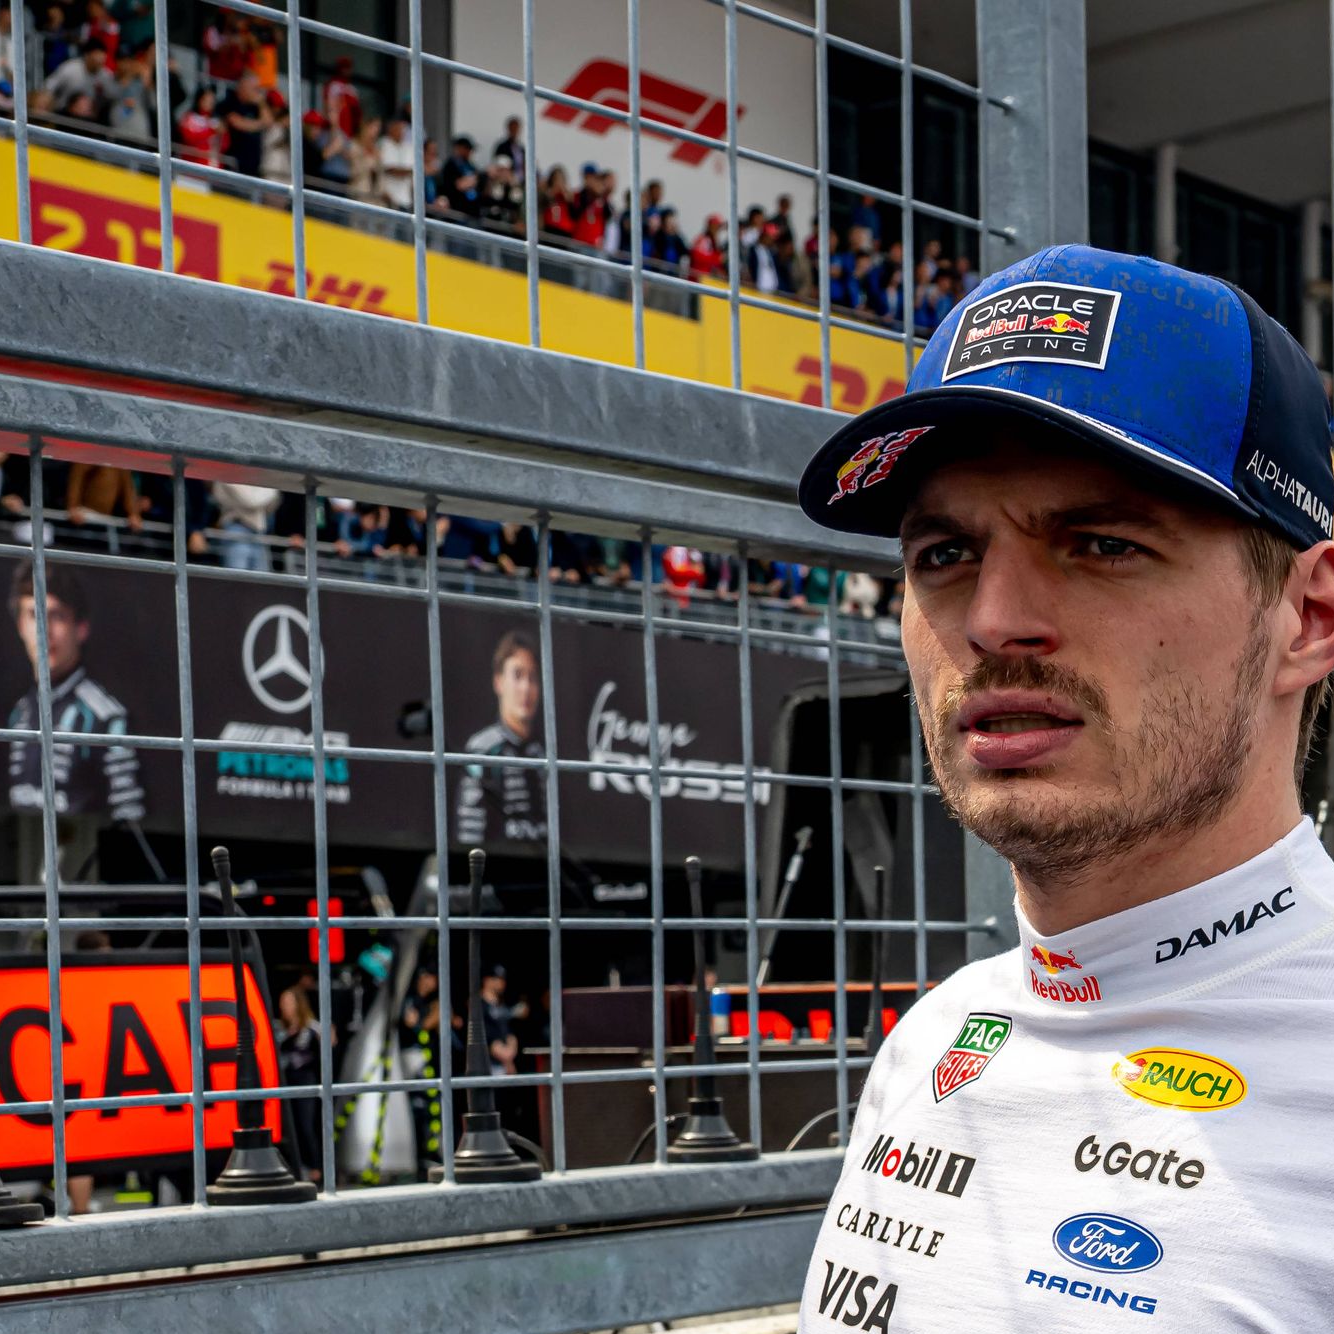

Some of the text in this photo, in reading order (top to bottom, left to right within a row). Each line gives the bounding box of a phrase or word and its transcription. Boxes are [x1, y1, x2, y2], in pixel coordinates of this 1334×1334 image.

[964, 313, 1027, 346] Red Bull
[972, 294, 1096, 325] ORACLE
[959, 337, 1088, 363] RACING
[1245, 449, 1334, 539] ALPHATAURI
[1155, 886, 1297, 965] DAMAC
[1031, 972, 1103, 1004] Red Bull
[960, 1021, 1005, 1051] TAG
[938, 1053, 984, 1091] HEUER
[1142, 1062, 1234, 1103] RAUCH
[861, 1134, 942, 1191] Mobil
[835, 1203, 946, 1259] CARLYLE
[1068, 1219, 1143, 1267] Ford
[1025, 1269, 1158, 1316] RACING
